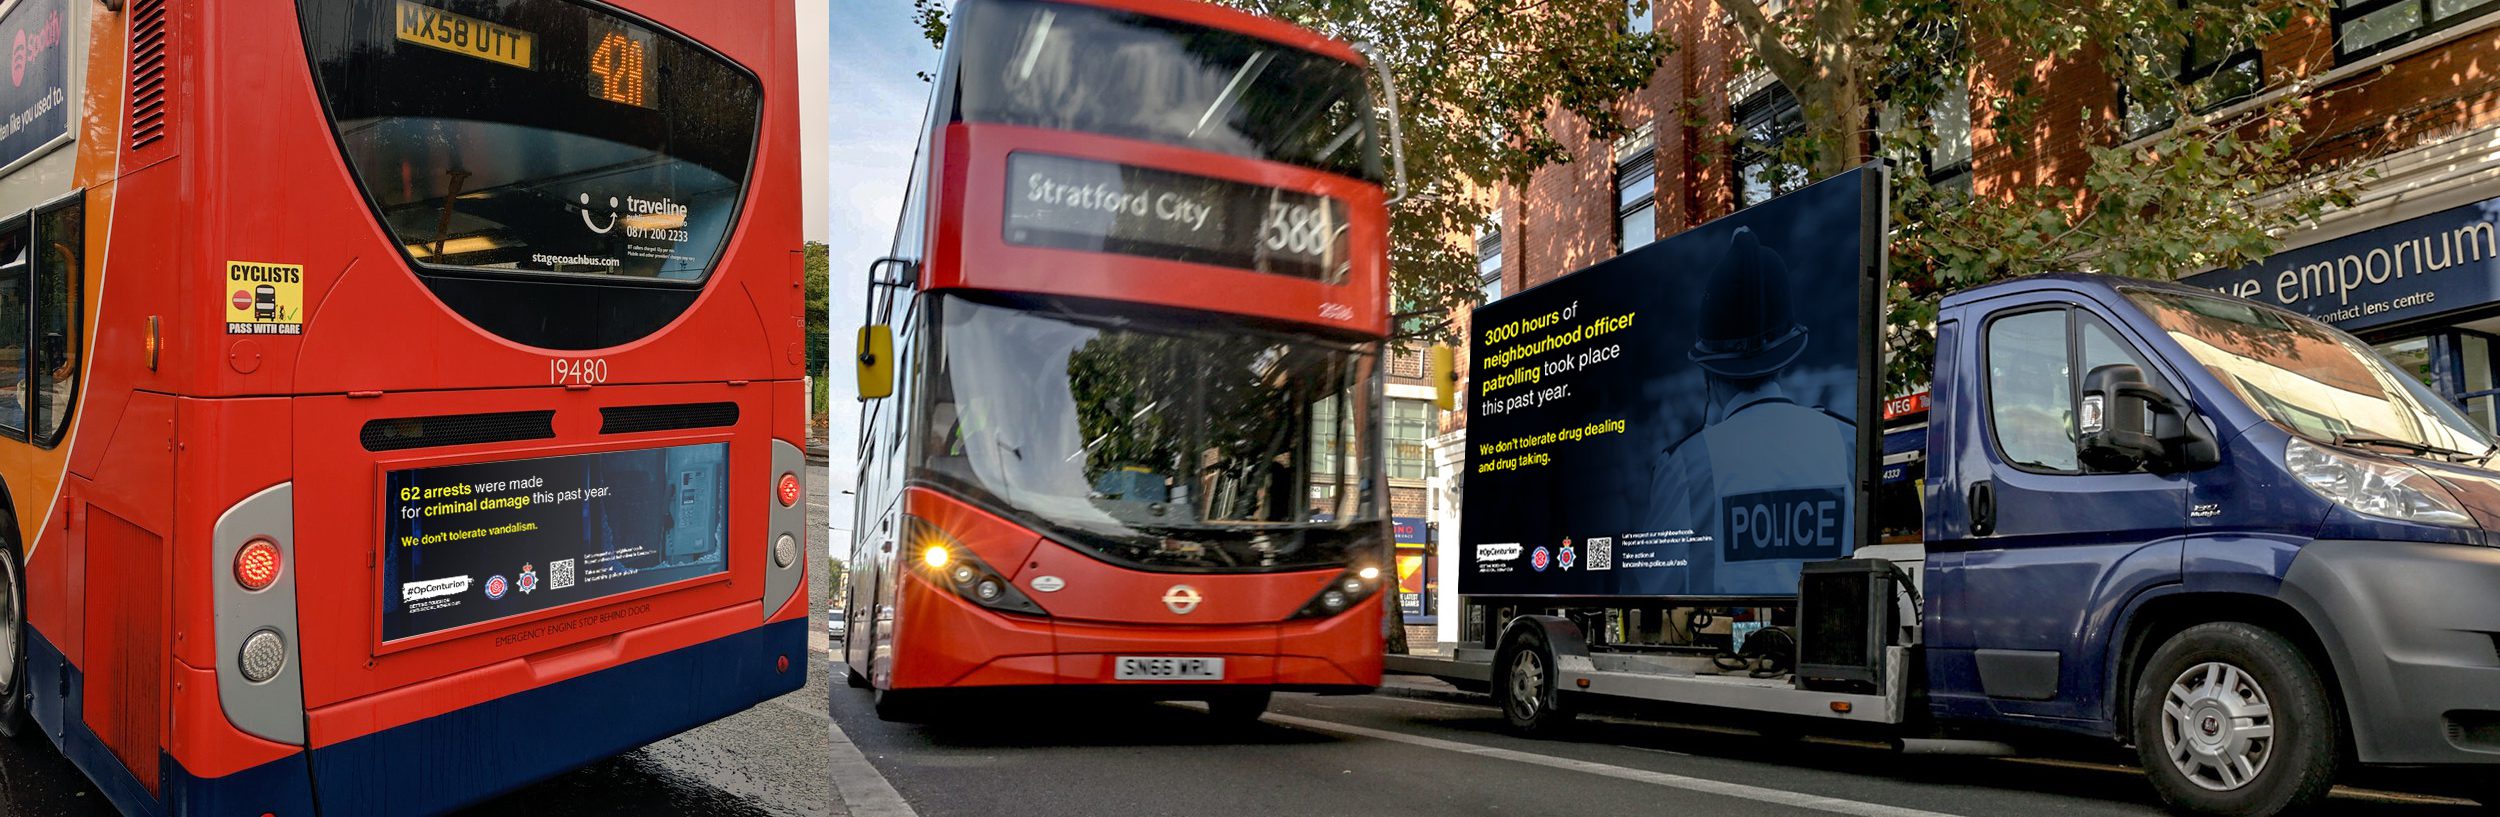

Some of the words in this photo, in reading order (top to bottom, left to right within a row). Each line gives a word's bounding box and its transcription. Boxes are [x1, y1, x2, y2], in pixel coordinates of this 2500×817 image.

[27, 8, 64, 64] Spotify
[403, 3, 468, 48] MX58
[476, 21, 521, 60] UTT
[592, 31, 642, 106] 42A
[21, 106, 33, 133] you
[34, 86, 52, 118] used
[627, 195, 688, 217] traveline
[1027, 172, 1149, 217] Stratford
[1155, 192, 1212, 231] City
[1268, 202, 1327, 256] 388
[627, 225, 648, 239] 0871
[651, 228, 666, 240] 200
[668, 229, 689, 242] 2233
[231, 264, 299, 284] CYCLISTS
[532, 253, 620, 267] stagecoachbus.com
[2276, 221, 2497, 305] emporium
[1484, 321, 1519, 346] 3000
[1521, 311, 1560, 334] hours
[1562, 300, 1578, 320] of
[2317, 305, 2360, 323] contact
[2363, 301, 2390, 316] lens
[2393, 289, 2436, 309] centre
[229, 323, 252, 334] PASS
[254, 323, 278, 334] WITH
[279, 324, 300, 334] CARE
[1483, 325, 1582, 370] neighbourhood
[1585, 312, 1635, 339] officer
[551, 359, 607, 384] 19480
[1482, 366, 1541, 397] patrolling
[1544, 354, 1575, 376] took
[1579, 344, 1620, 372] place
[1482, 397, 1504, 416] this
[1506, 390, 1534, 414] past
[1537, 383, 1571, 408] year.
[1887, 398, 1910, 415] VEG
[1480, 443, 1494, 456] We
[1495, 438, 1518, 453] don't
[1519, 431, 1556, 448] tolerate
[1558, 427, 1582, 442] drug
[1584, 419, 1625, 437] dealing
[1478, 459, 1495, 473] and
[1496, 456, 1517, 471] drug
[1519, 452, 1551, 467] taking.
[401, 487, 420, 501] 62
[424, 483, 472, 499] arrests
[475, 480, 506, 493] were
[509, 476, 543, 490] made
[401, 506, 421, 519] for
[424, 499, 477, 517] criminal
[480, 494, 530, 511] damage
[533, 491, 554, 503] this
[557, 488, 581, 504] past
[584, 485, 612, 501] year.
[401, 536, 419, 547] We
[421, 532, 447, 545] don't
[449, 528, 487, 542] tolerate
[489, 521, 539, 536] vandalism.
[1731, 500, 1836, 550] POLICE
[407, 580, 465, 595] #OpCenturion
[495, 628, 546, 647] EMERGENCY
[547, 621, 577, 636] ENGINE
[578, 615, 598, 628] STOP
[600, 609, 627, 623] BEHIND
[628, 604, 650, 616] DOOR
